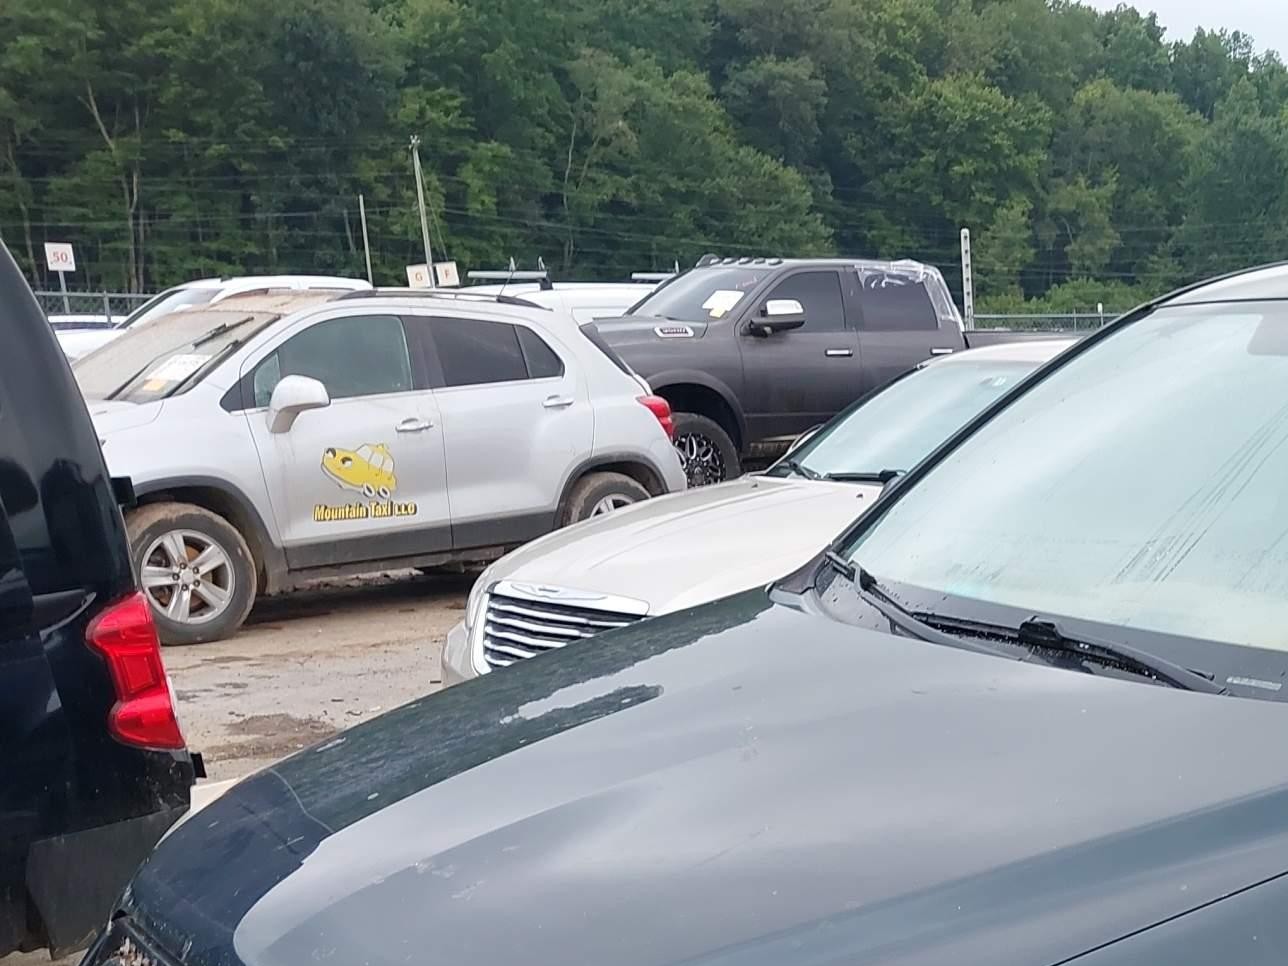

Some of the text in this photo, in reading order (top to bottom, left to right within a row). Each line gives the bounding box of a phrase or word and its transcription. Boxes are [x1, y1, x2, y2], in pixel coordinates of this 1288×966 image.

[53, 251, 68, 263] 50
[314, 503, 368, 521] Mountain
[369, 500, 394, 518] Taxi
